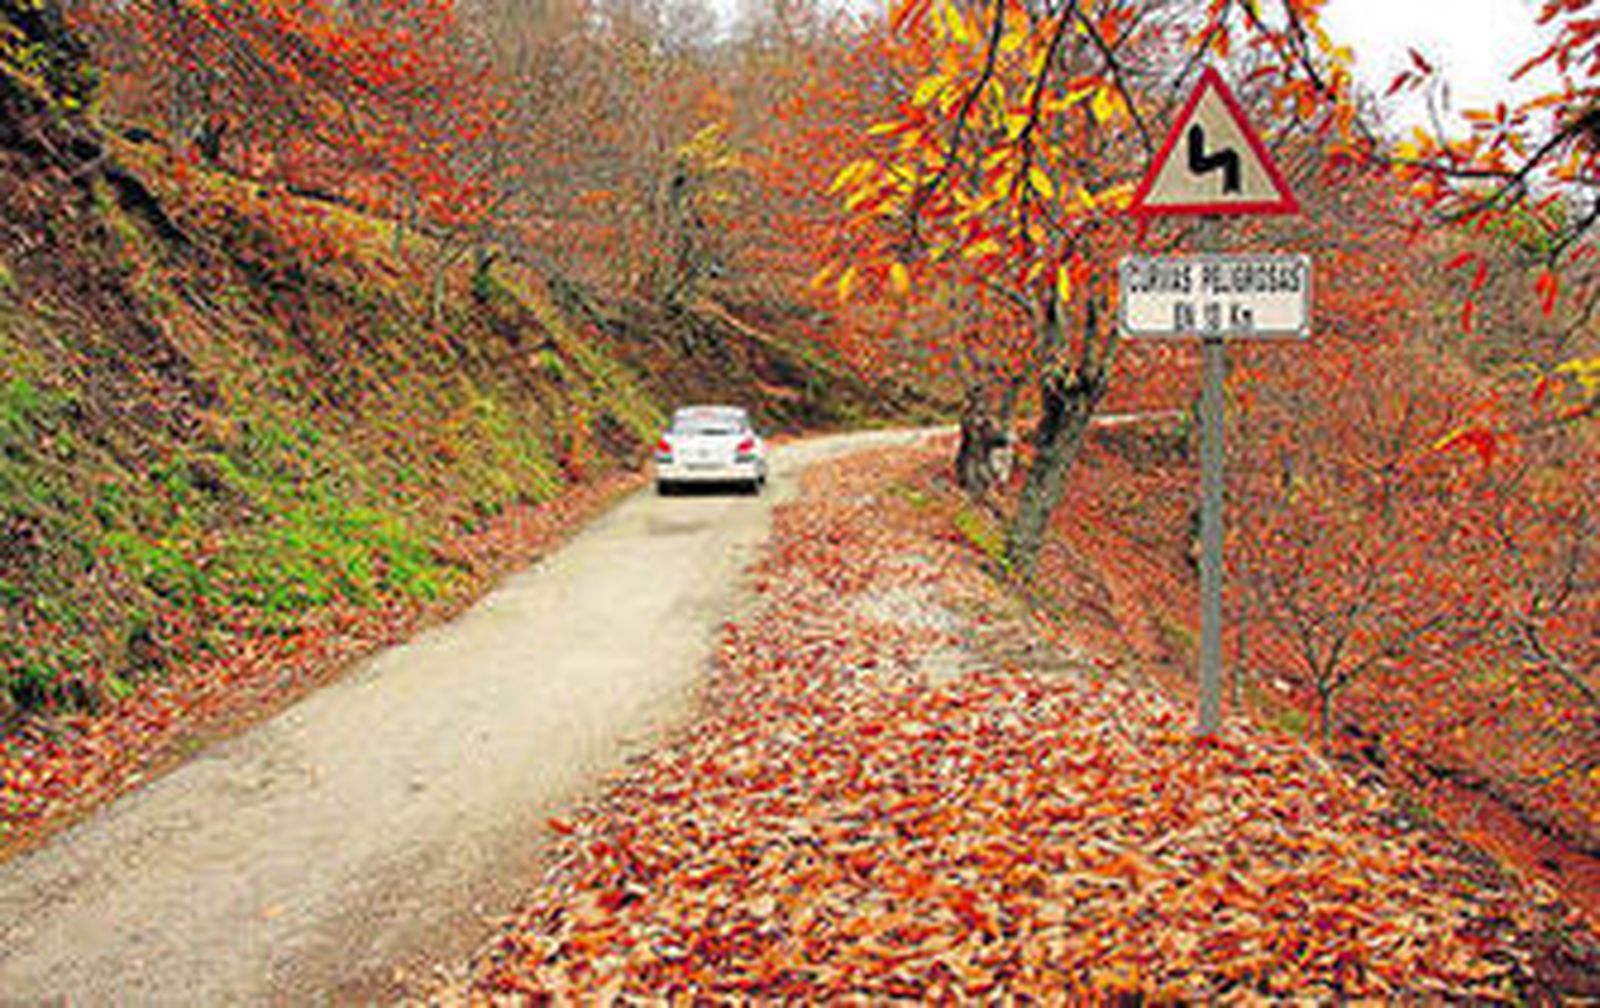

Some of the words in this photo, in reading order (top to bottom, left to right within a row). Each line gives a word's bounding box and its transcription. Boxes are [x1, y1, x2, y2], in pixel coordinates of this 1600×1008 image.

[1129, 264, 1191, 294] CURVAS
[1202, 264, 1301, 294] PELIGROSAS
[1174, 303, 1197, 331] EN
